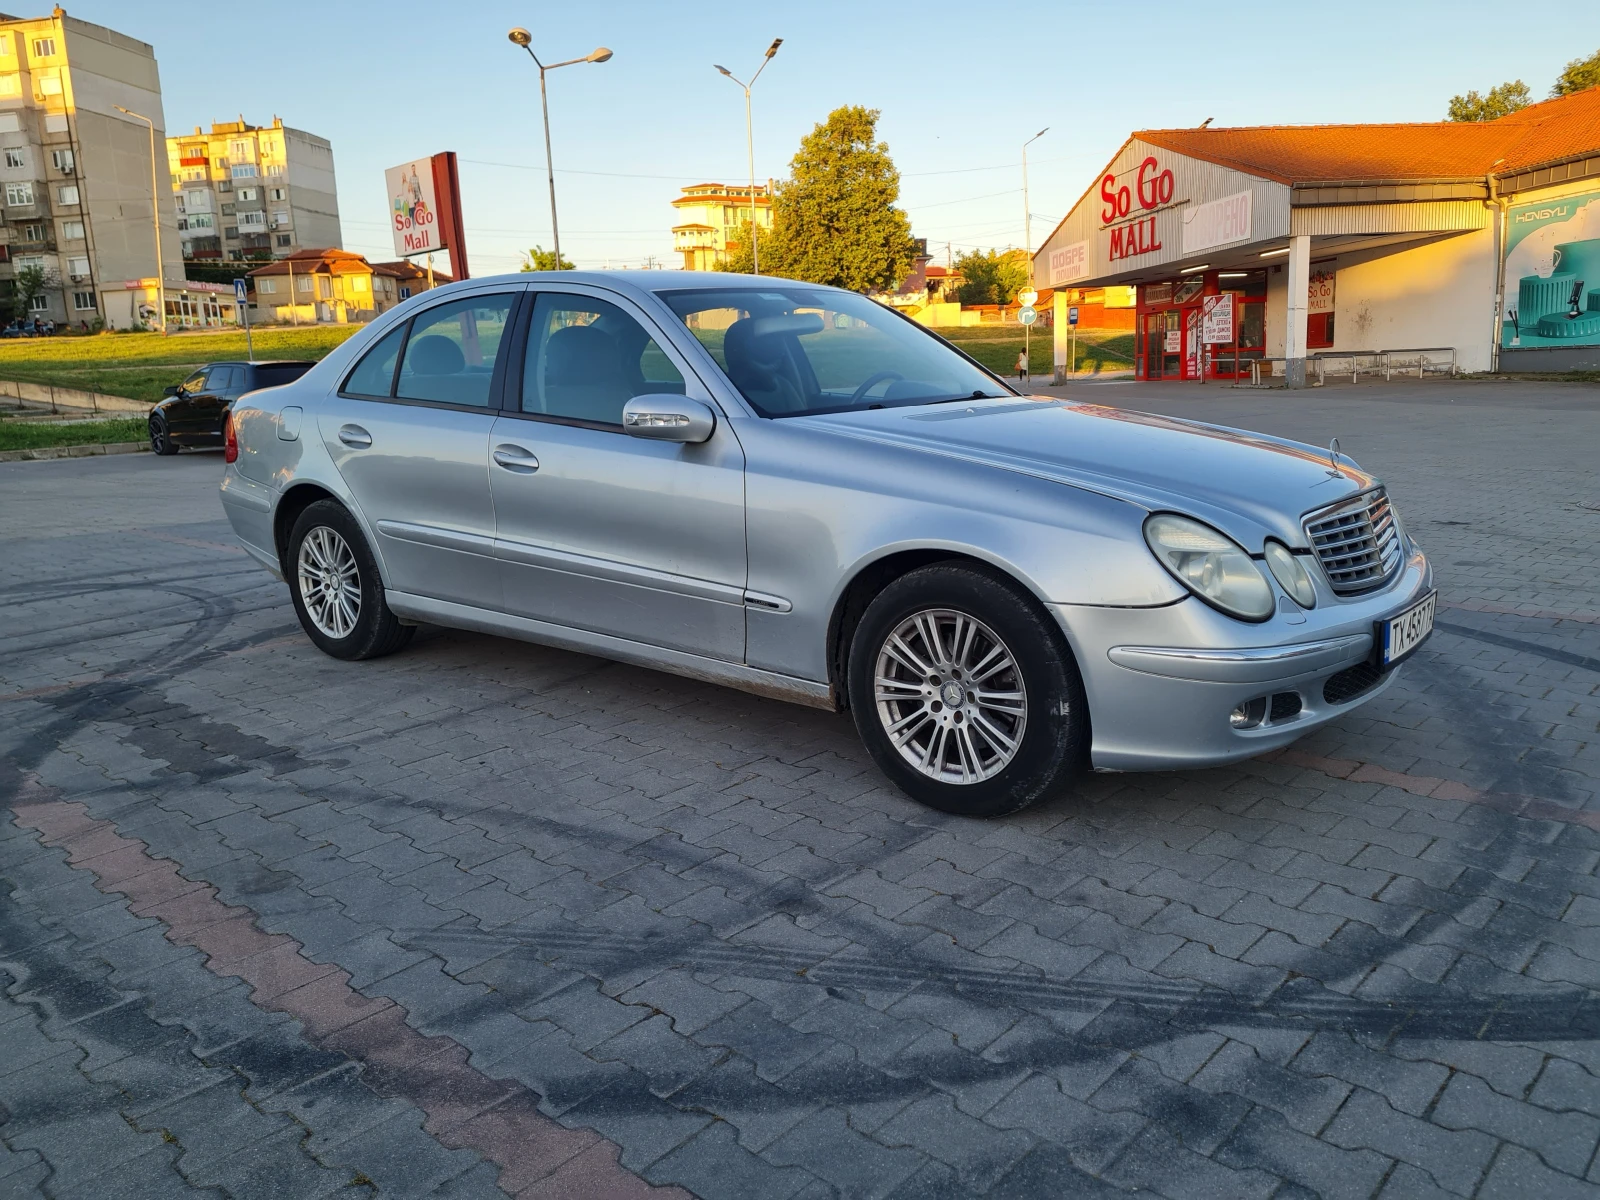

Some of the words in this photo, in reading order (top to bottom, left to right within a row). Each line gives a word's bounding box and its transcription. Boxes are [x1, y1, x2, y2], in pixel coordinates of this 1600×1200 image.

[1101, 174, 1131, 224] So
[1137, 156, 1174, 210] Go
[396, 214, 411, 230] So
[415, 208, 433, 226] Go
[404, 230, 430, 252] Mall
[1109, 216, 1162, 262] MALL
[1052, 246, 1084, 269] ДОБРЕ
[1308, 286, 1318, 298] So
[1320, 284, 1330, 296] Go
[1310, 300, 1327, 309] MALL
[1393, 619, 1405, 654] TX
